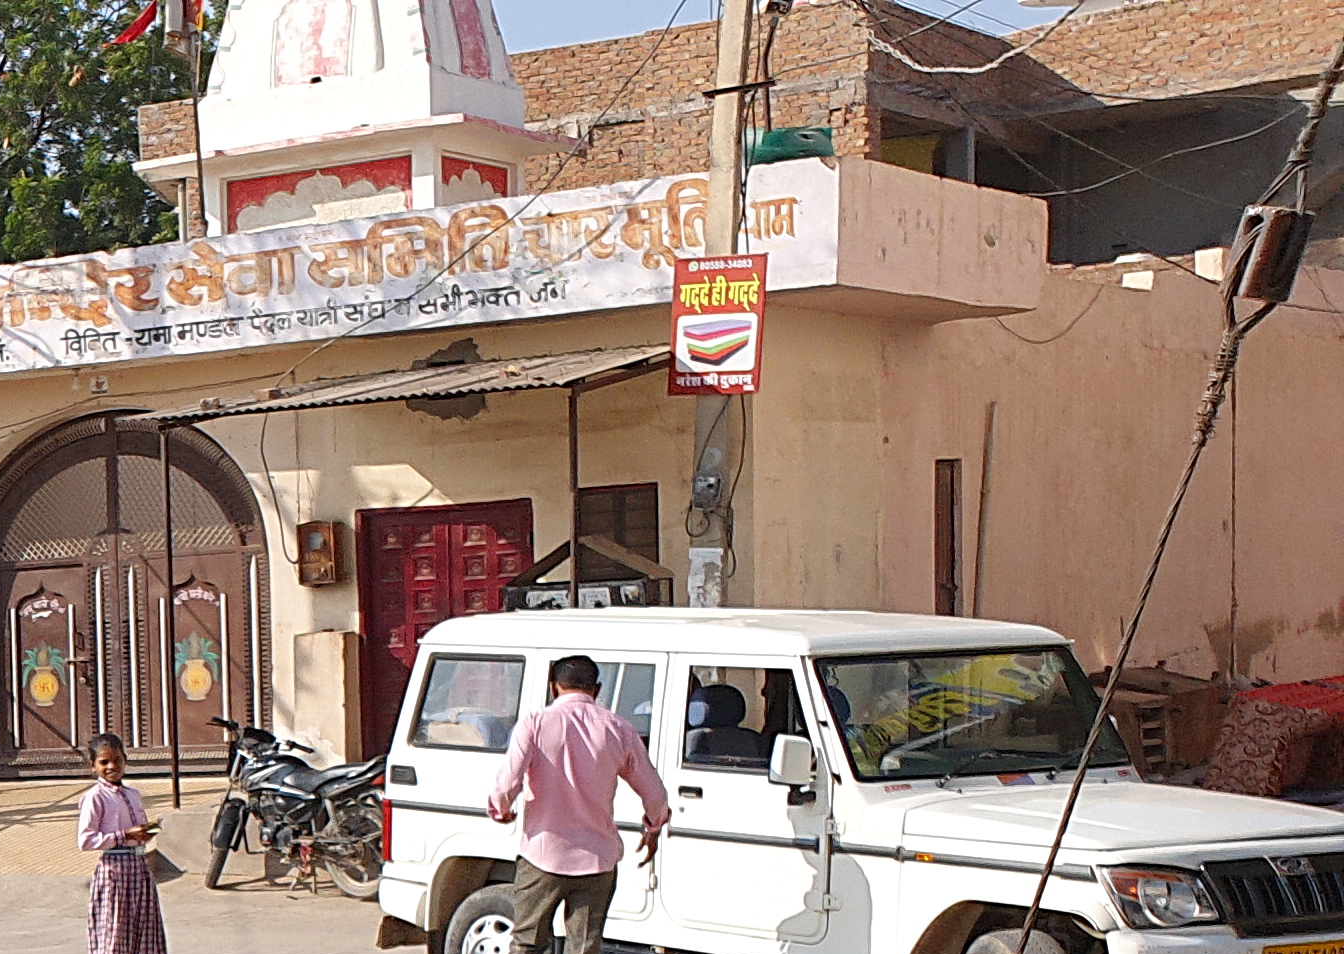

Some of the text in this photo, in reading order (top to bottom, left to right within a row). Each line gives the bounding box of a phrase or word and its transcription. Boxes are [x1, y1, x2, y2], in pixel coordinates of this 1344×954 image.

[164, 241, 304, 307] सेवा
[307, 204, 511, 288] समिति
[711, 275, 727, 306] ही
